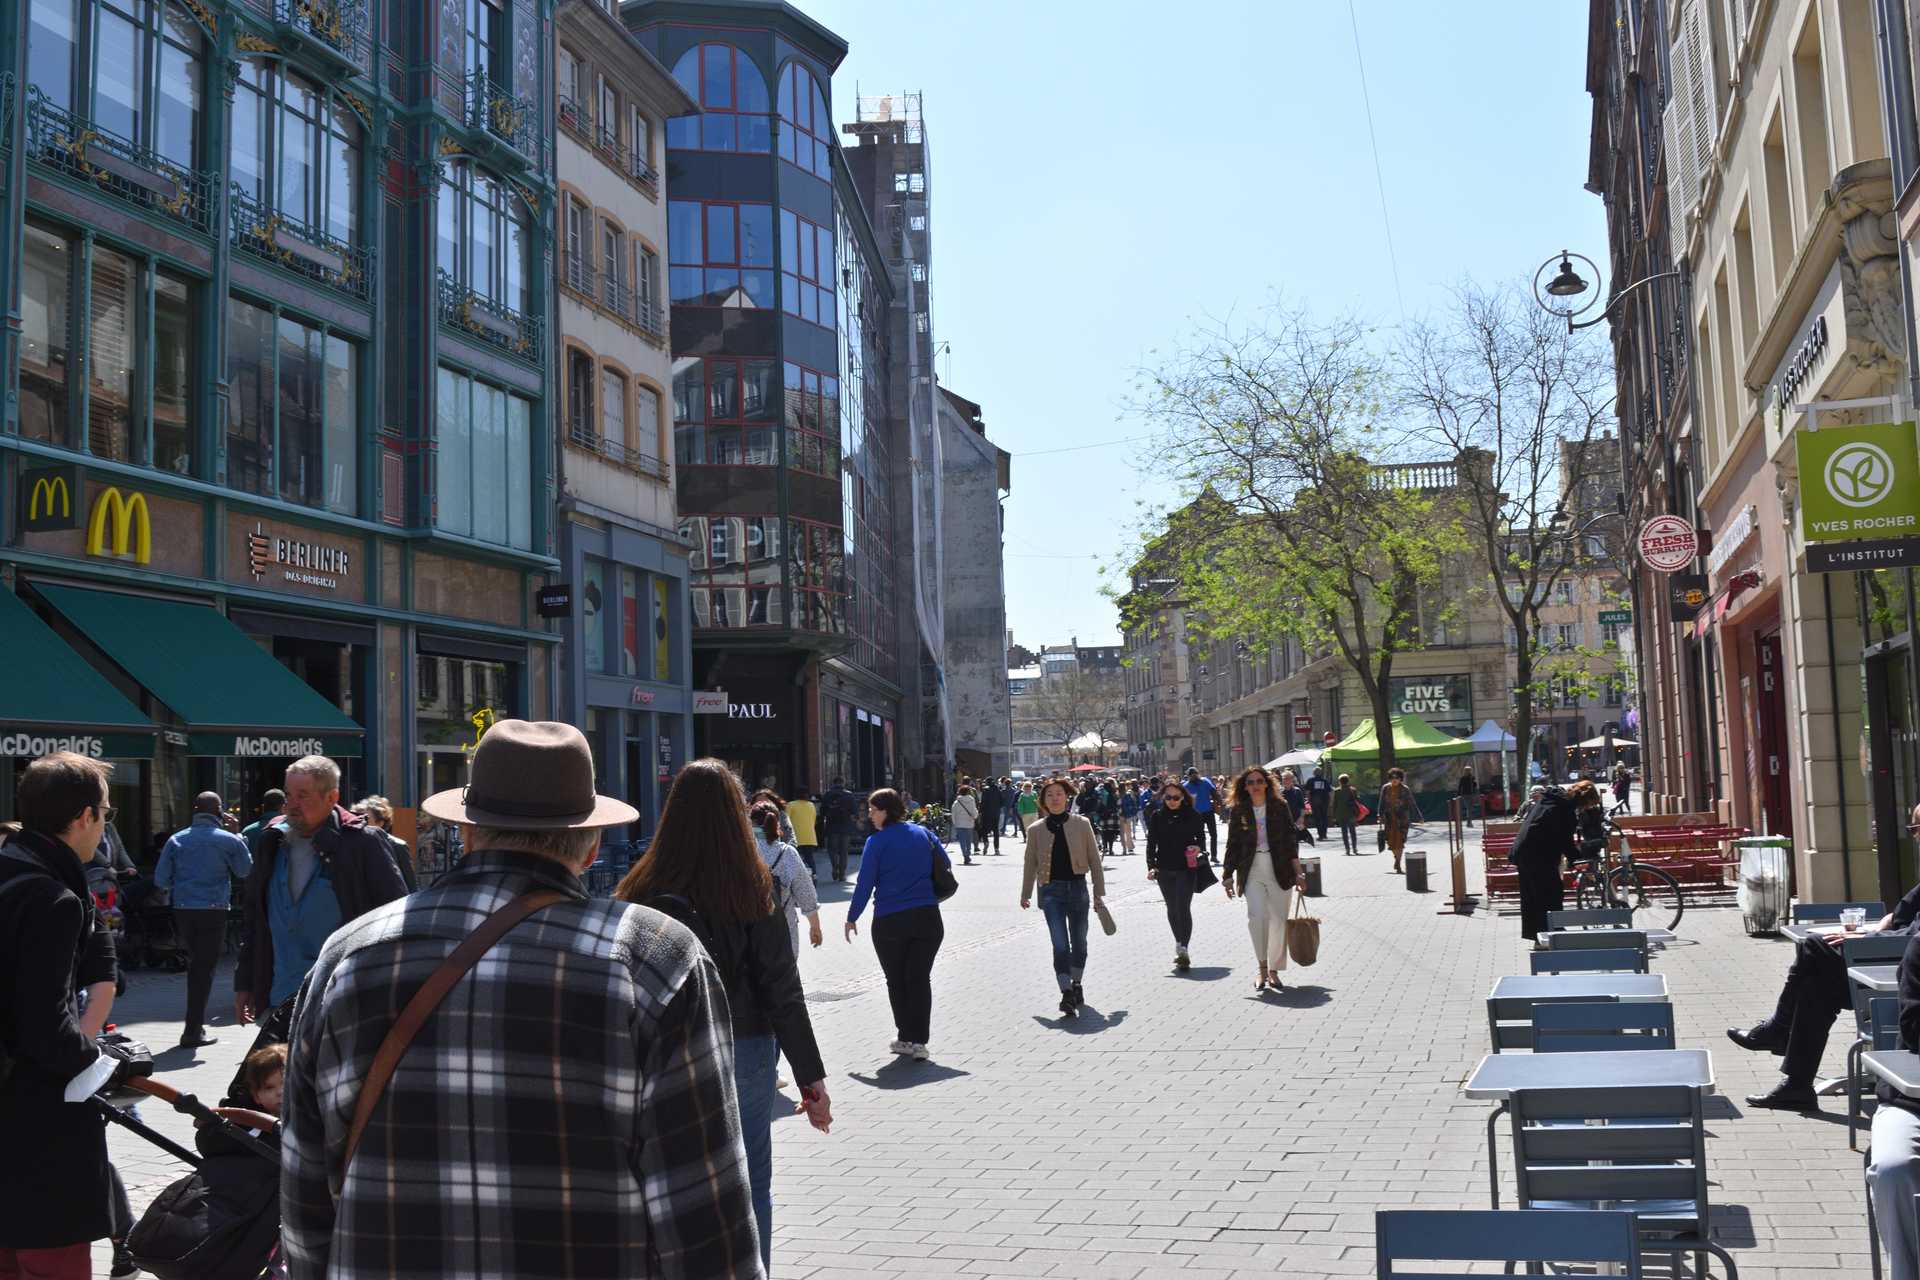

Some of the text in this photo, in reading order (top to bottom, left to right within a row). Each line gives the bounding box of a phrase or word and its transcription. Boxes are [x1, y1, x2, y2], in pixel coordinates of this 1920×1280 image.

[1811, 515, 1916, 532] YVES ROCHER
[1641, 533, 1694, 549] FRESH
[276, 538, 349, 575] BERLINER
[1643, 543, 1696, 556] BURRITOS
[1828, 548, 1904, 562] L'INSTITUT
[1602, 613, 1626, 621] JULES
[1405, 686, 1445, 699] FIVE
[728, 703, 776, 719] PAUL
[1401, 699, 1450, 713] GUYS
[0, 733, 103, 757] cDonald's
[235, 737, 323, 756] McDonald's
